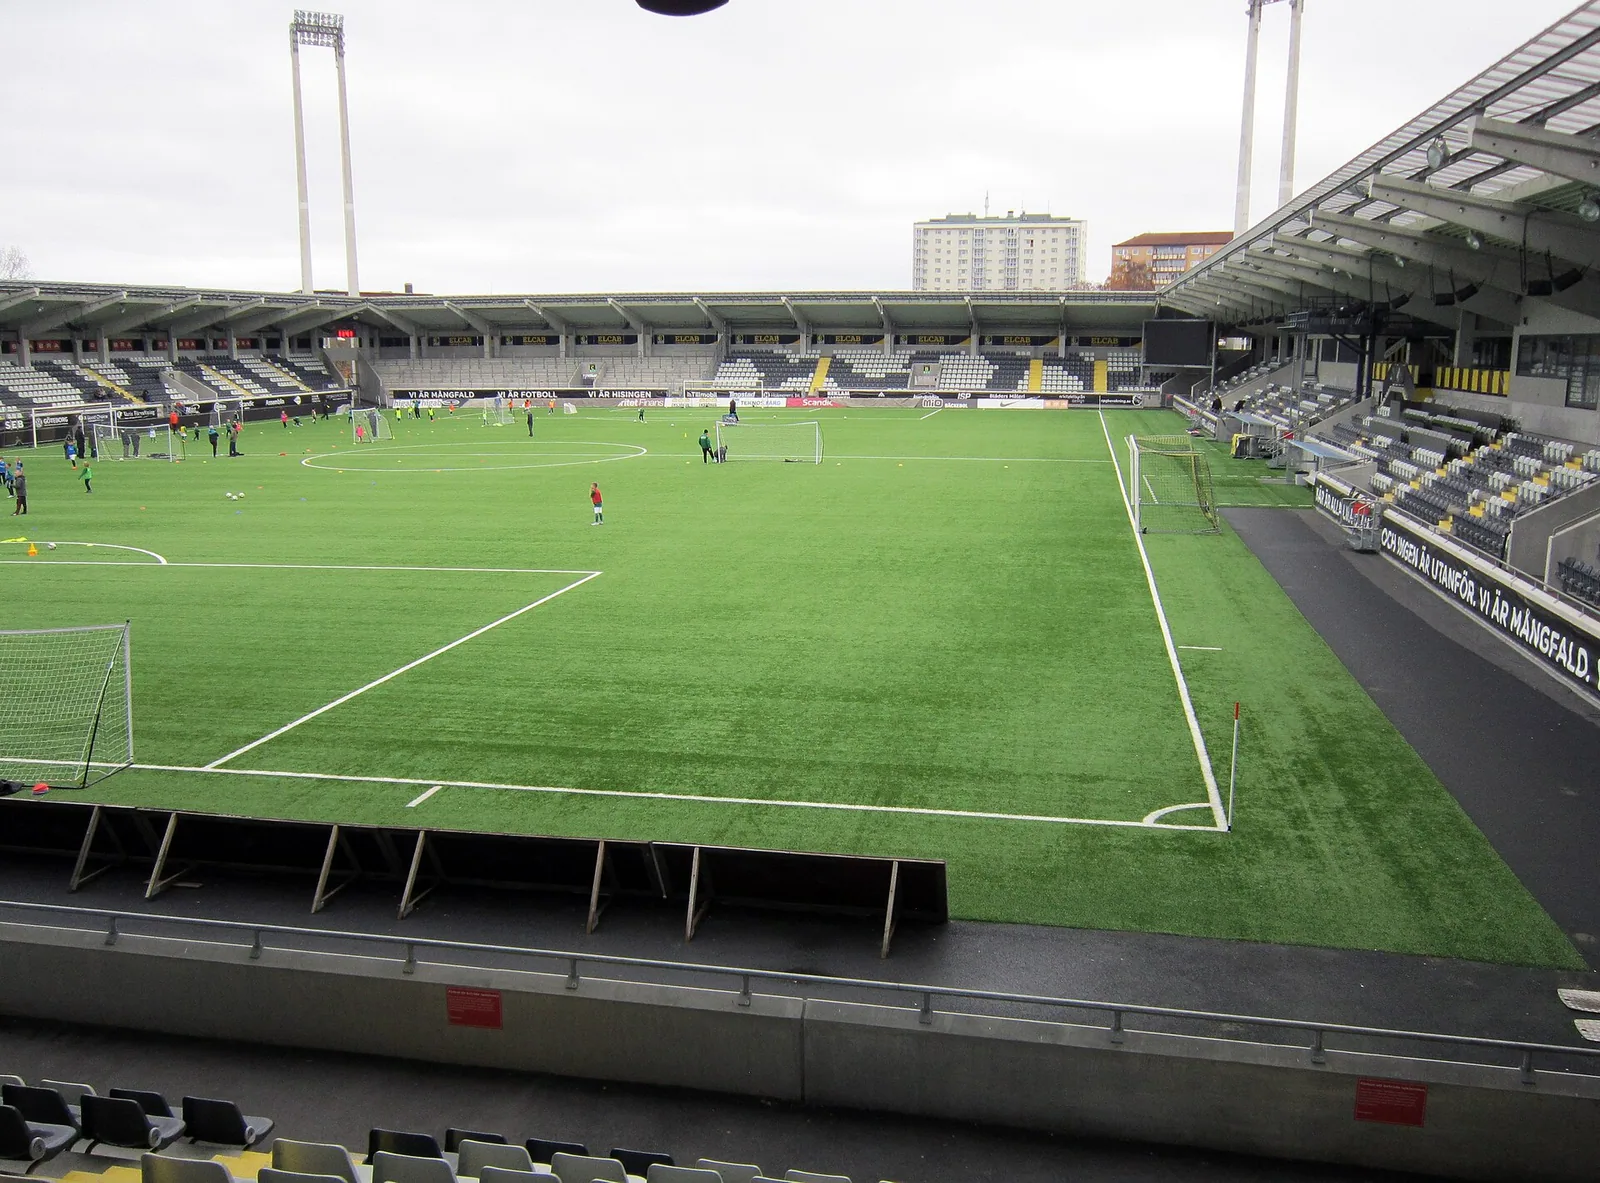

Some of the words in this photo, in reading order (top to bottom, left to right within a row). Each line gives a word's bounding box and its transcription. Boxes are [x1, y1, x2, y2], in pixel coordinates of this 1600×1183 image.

[418, 390, 430, 398] ÄR
[431, 390, 475, 398] MÅNGFALD
[507, 390, 518, 398] ÄR
[600, 389, 610, 398] ÄR
[5, 420, 24, 430] SEB
[1381, 528, 1396, 552] OCH
[1397, 536, 1419, 568] INGEN
[1419, 545, 1430, 576] ÄR
[1432, 558, 1476, 607] UTANFÖR.
[1480, 587, 1490, 615] VI
[1491, 589, 1509, 627] ÄR
[1510, 606, 1590, 682] MÅNGFALD.
